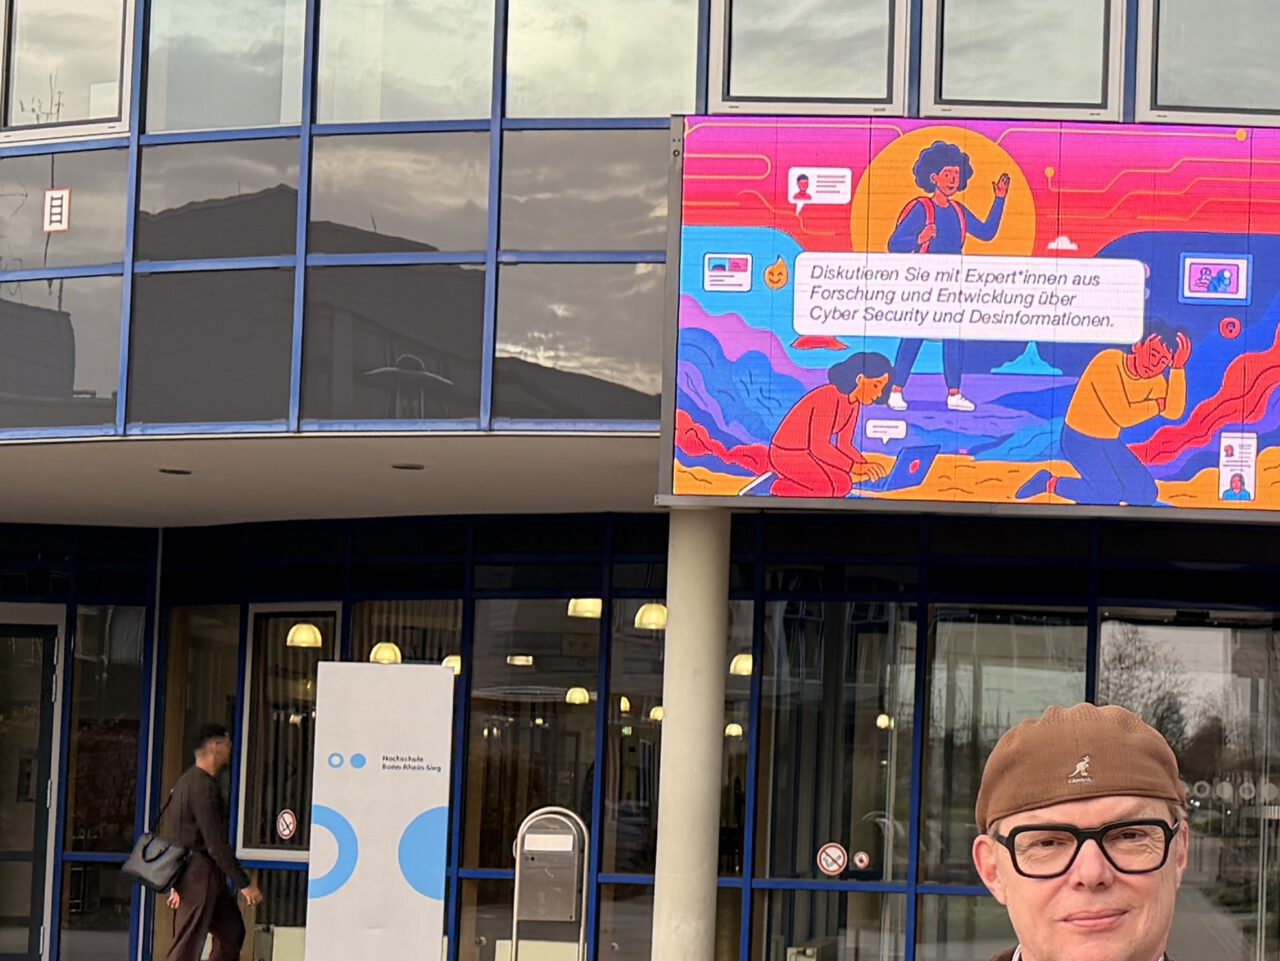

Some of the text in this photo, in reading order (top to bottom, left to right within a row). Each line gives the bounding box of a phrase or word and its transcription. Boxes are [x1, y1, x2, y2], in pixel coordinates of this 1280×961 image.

[810, 265, 899, 281] Diskutieren
[904, 266, 930, 282] Sie
[934, 268, 960, 283] mit
[1072, 274, 1101, 287] aus
[809, 285, 1077, 308] Forschung und Entwicklung über
[809, 305, 1115, 327] Cyber Security und Desinformationen.
